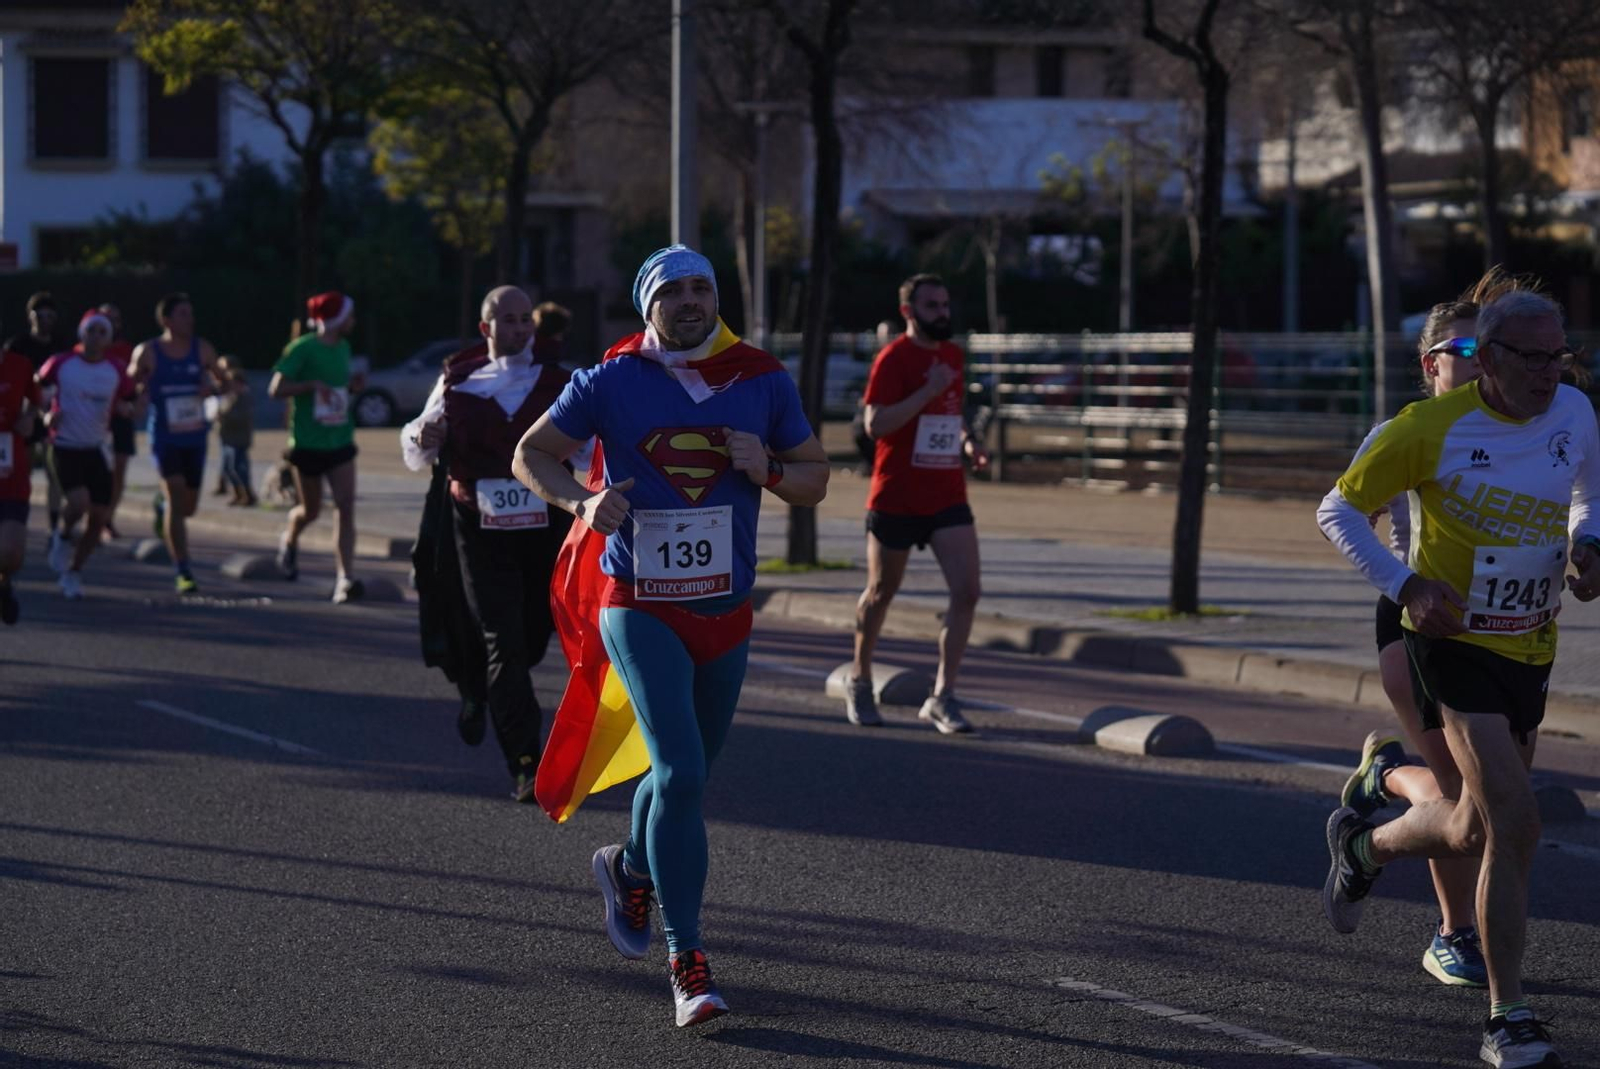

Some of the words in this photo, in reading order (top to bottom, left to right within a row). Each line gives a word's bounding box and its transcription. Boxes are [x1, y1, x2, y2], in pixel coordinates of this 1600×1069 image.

[929, 433, 955, 450] 567
[494, 488, 532, 509] 307
[657, 540, 713, 569] 139
[644, 579, 715, 595] Cruzcampo
[1486, 577, 1551, 611] 1243
